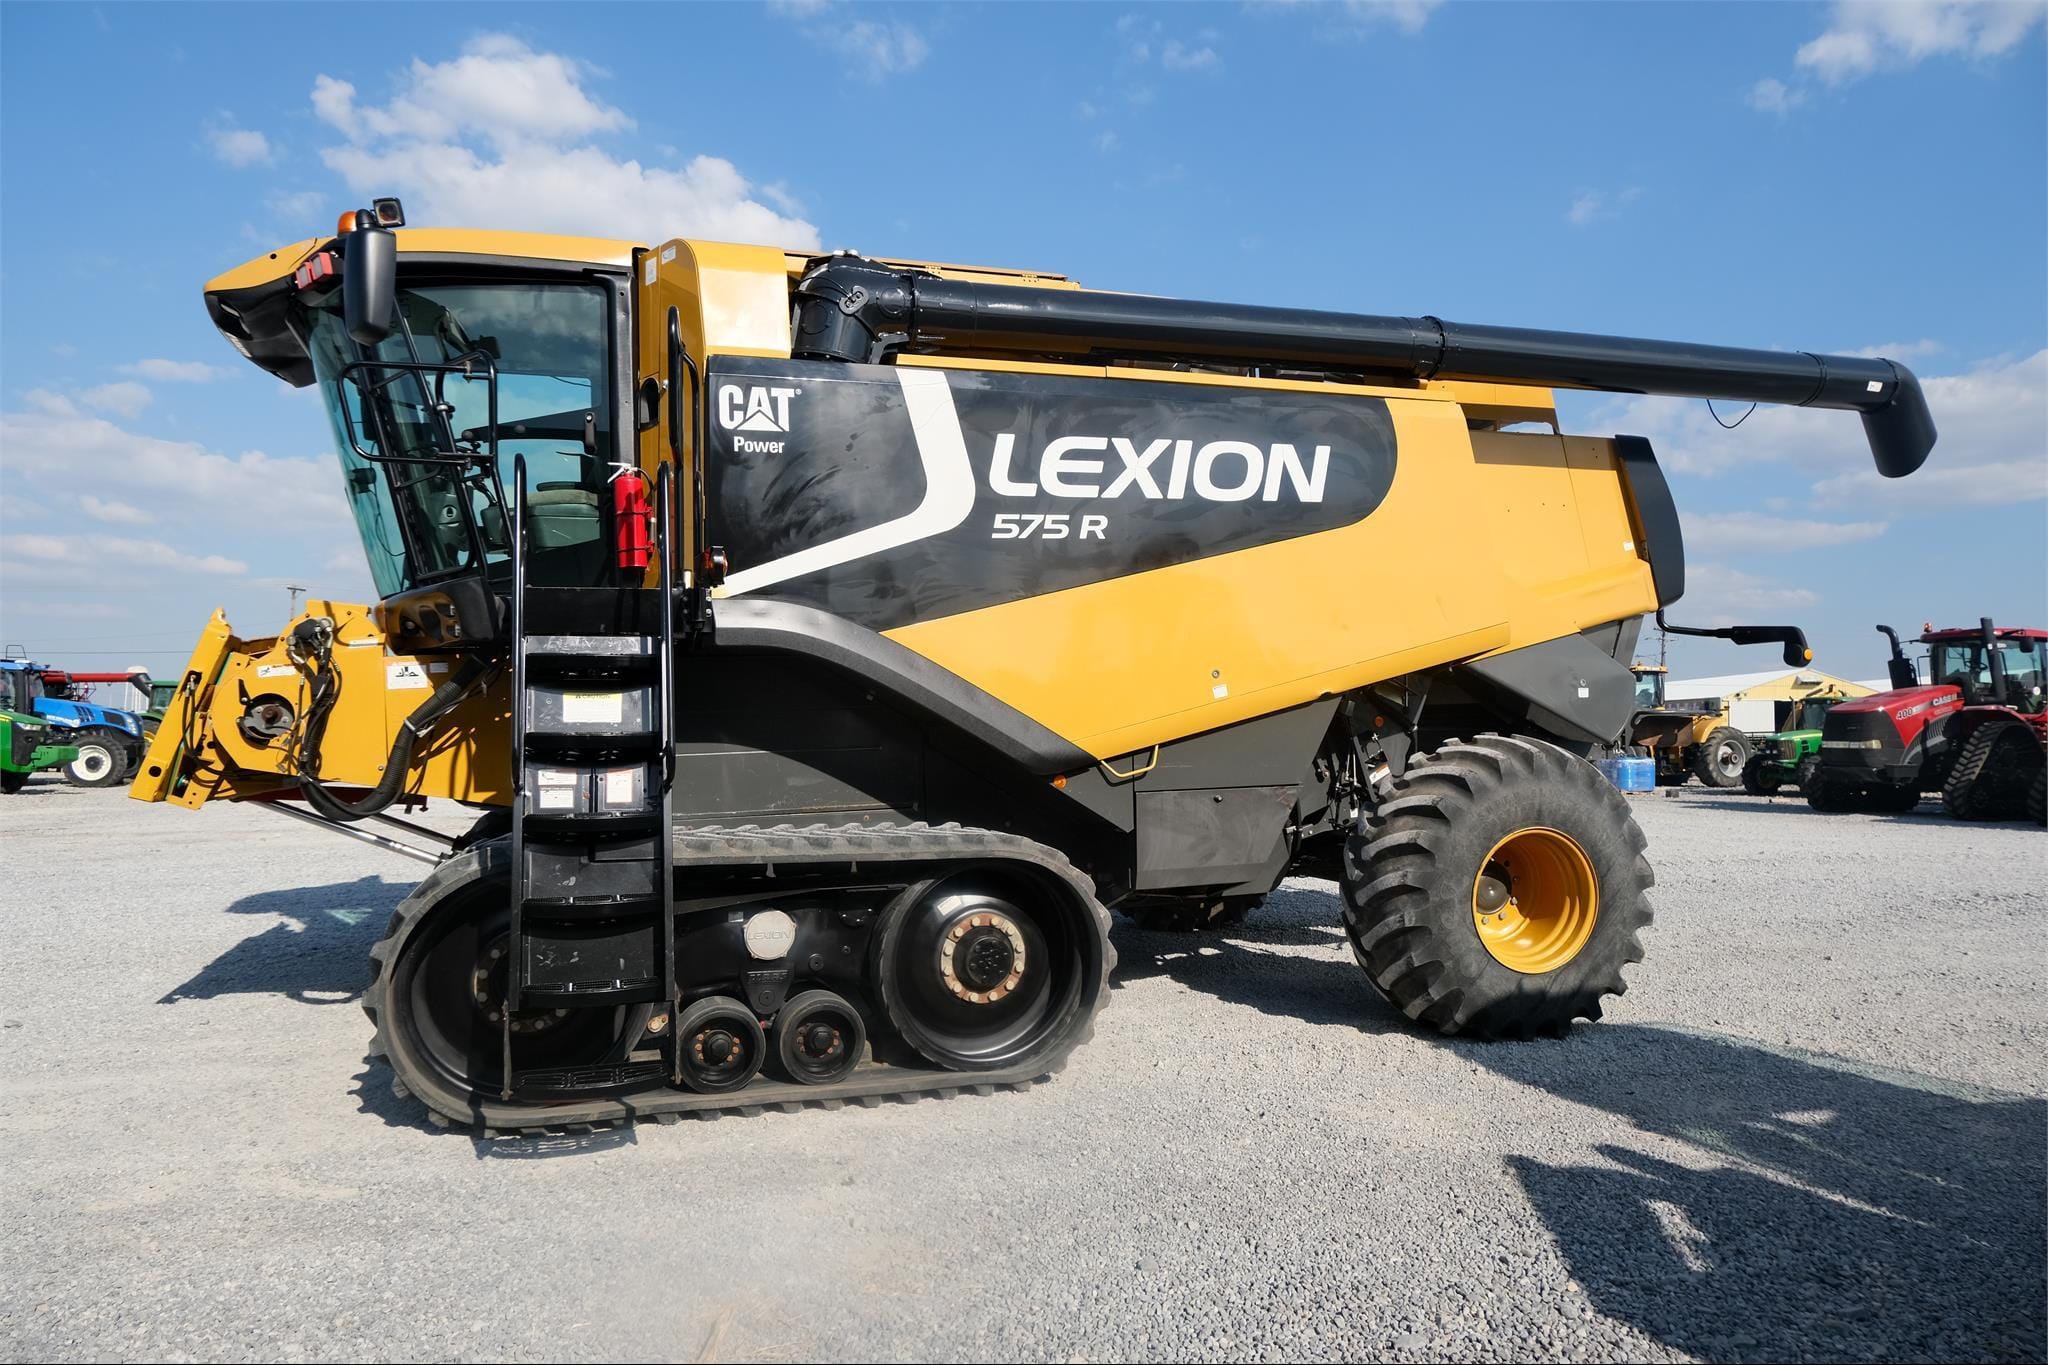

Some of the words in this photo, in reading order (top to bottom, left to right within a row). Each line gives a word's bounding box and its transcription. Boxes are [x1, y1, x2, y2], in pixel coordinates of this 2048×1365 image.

[733, 436, 785, 454] Power
[989, 433, 1331, 503] LEXION
[991, 514, 1069, 539] 575
[1079, 515, 1109, 540] R
